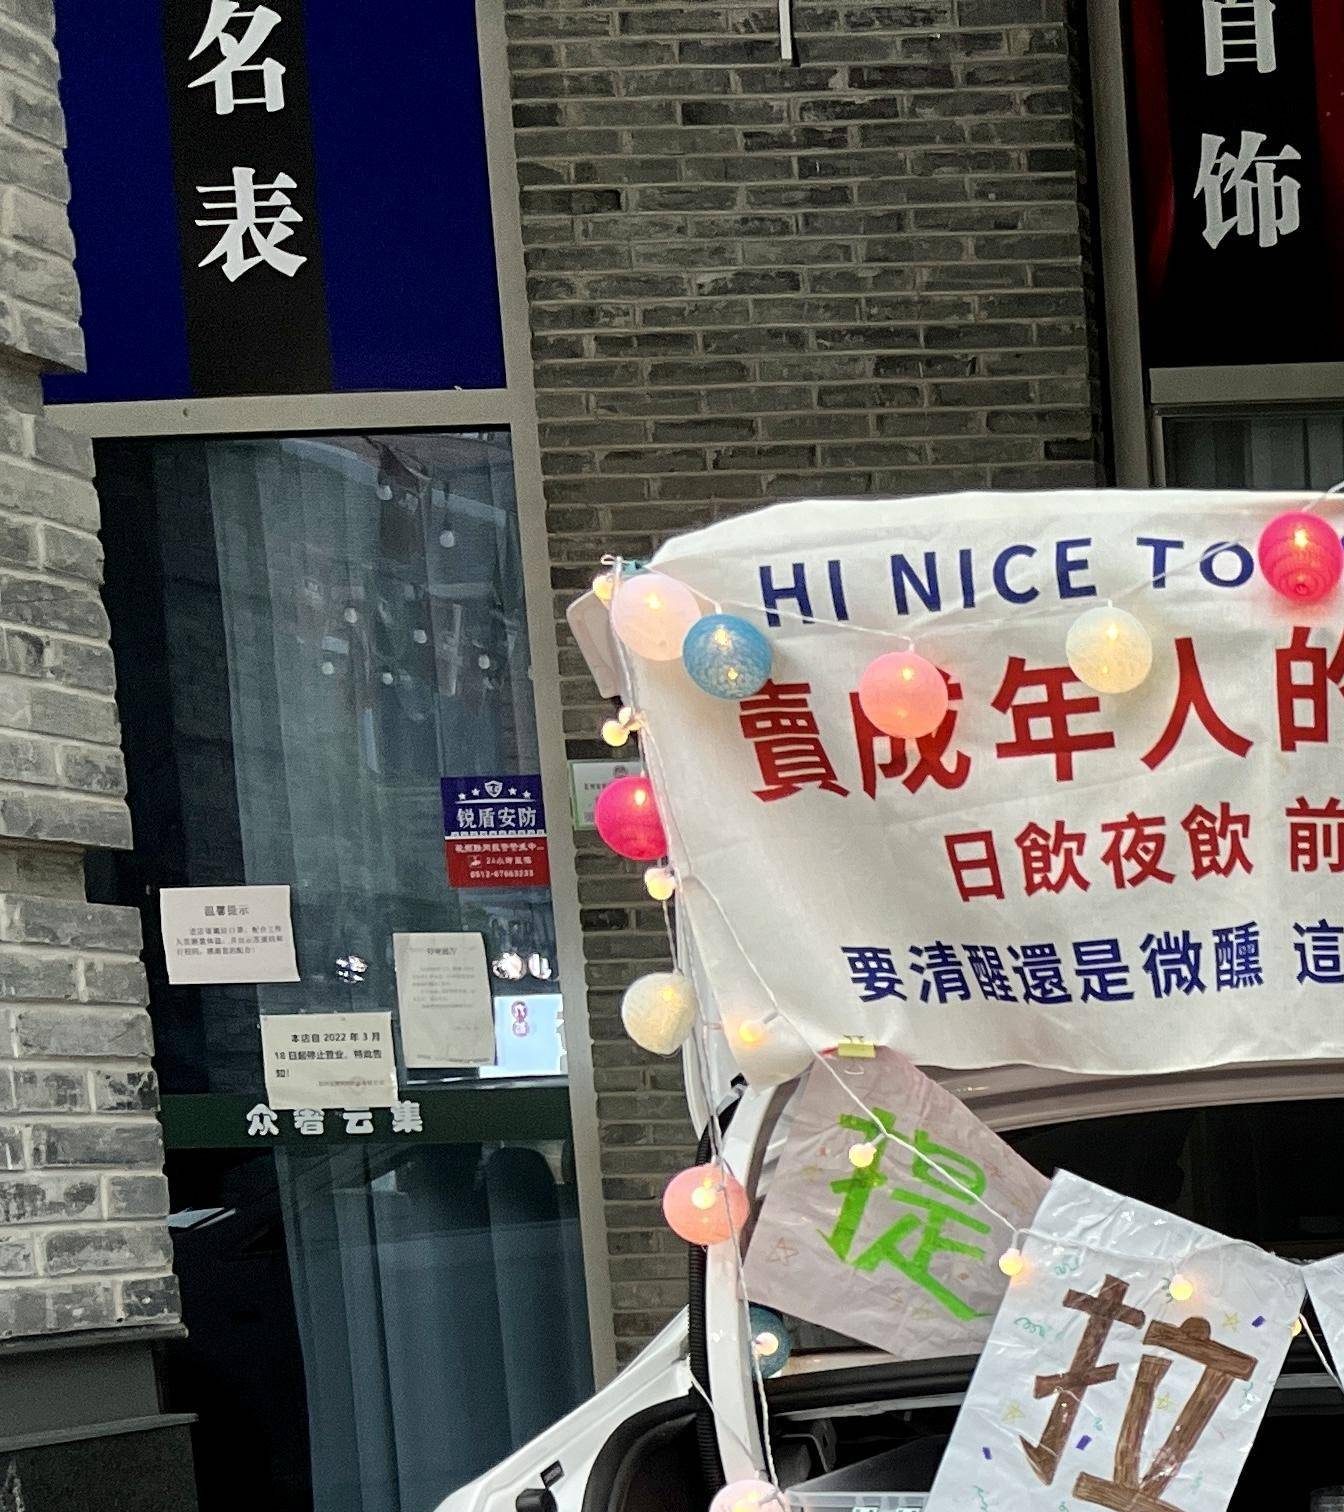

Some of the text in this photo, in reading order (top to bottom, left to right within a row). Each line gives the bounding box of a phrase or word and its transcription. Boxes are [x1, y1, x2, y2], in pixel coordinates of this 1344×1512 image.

[187, 0, 308, 283] 名表
[757, 557, 850, 628] HI
[889, 536, 1098, 617] NICE
[1136, 535, 1256, 590] TO
[456, 806, 537, 829] 锐盾安防
[943, 802, 1254, 903] 日飲夜飲
[841, 920, 1265, 1005] 要清醒還是微醺
[323, 1033, 346, 1042] 2022
